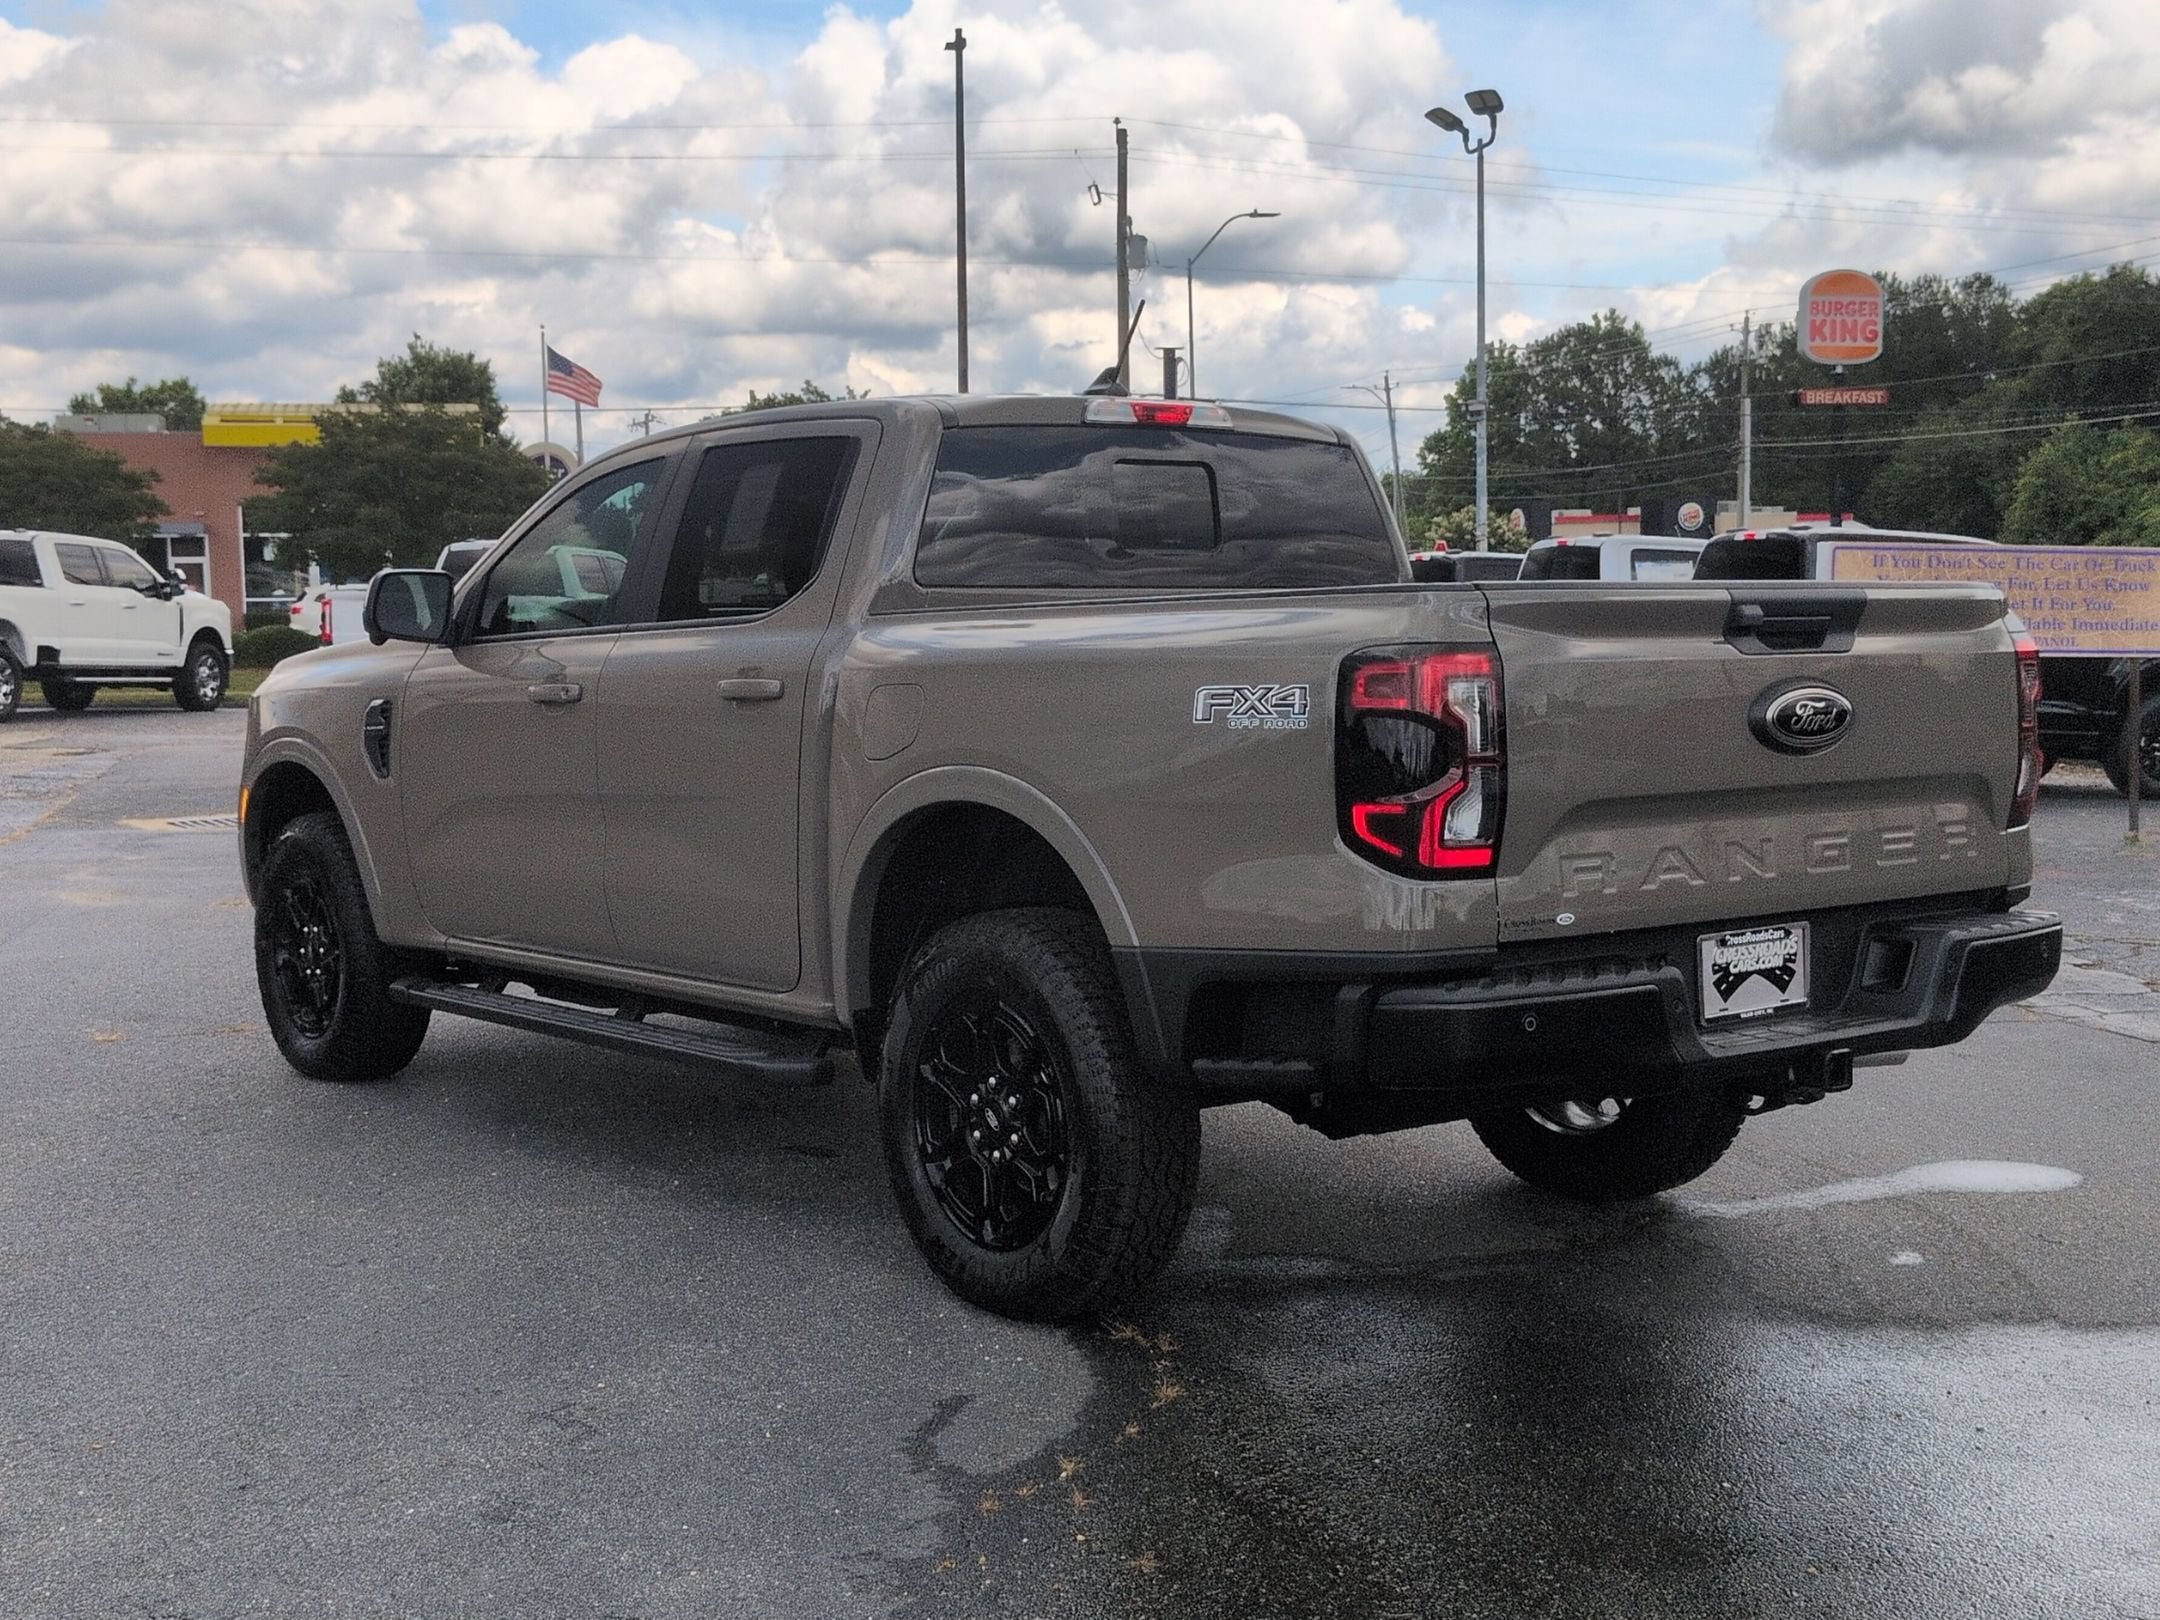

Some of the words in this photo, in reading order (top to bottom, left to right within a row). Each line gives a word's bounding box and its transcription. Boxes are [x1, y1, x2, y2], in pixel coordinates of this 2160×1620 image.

[1809, 300, 1879, 318] BURGER
[1809, 319, 1879, 343] KING
[1806, 390, 1884, 405] BREAKFAST
[1873, 554, 1885, 568] If
[1892, 554, 1920, 569] You
[1928, 554, 1971, 569] Don't
[1978, 556, 2006, 570] See
[2013, 557, 2044, 570] The
[2050, 558, 2079, 571] Car
[2113, 558, 2157, 572] Truck
[2043, 576, 2071, 591] Let
[2077, 577, 2099, 591] Us
[2105, 577, 2151, 592] Know
[2010, 599, 2025, 611] et
[2032, 597, 2043, 610] It
[2050, 597, 2078, 610] For
[1193, 684, 1310, 723] FX4
[1228, 718, 1260, 729] OFF
[1264, 718, 1308, 729] ROAD
[1790, 701, 1837, 732] Ford
[1558, 816, 1979, 899] RANGER
